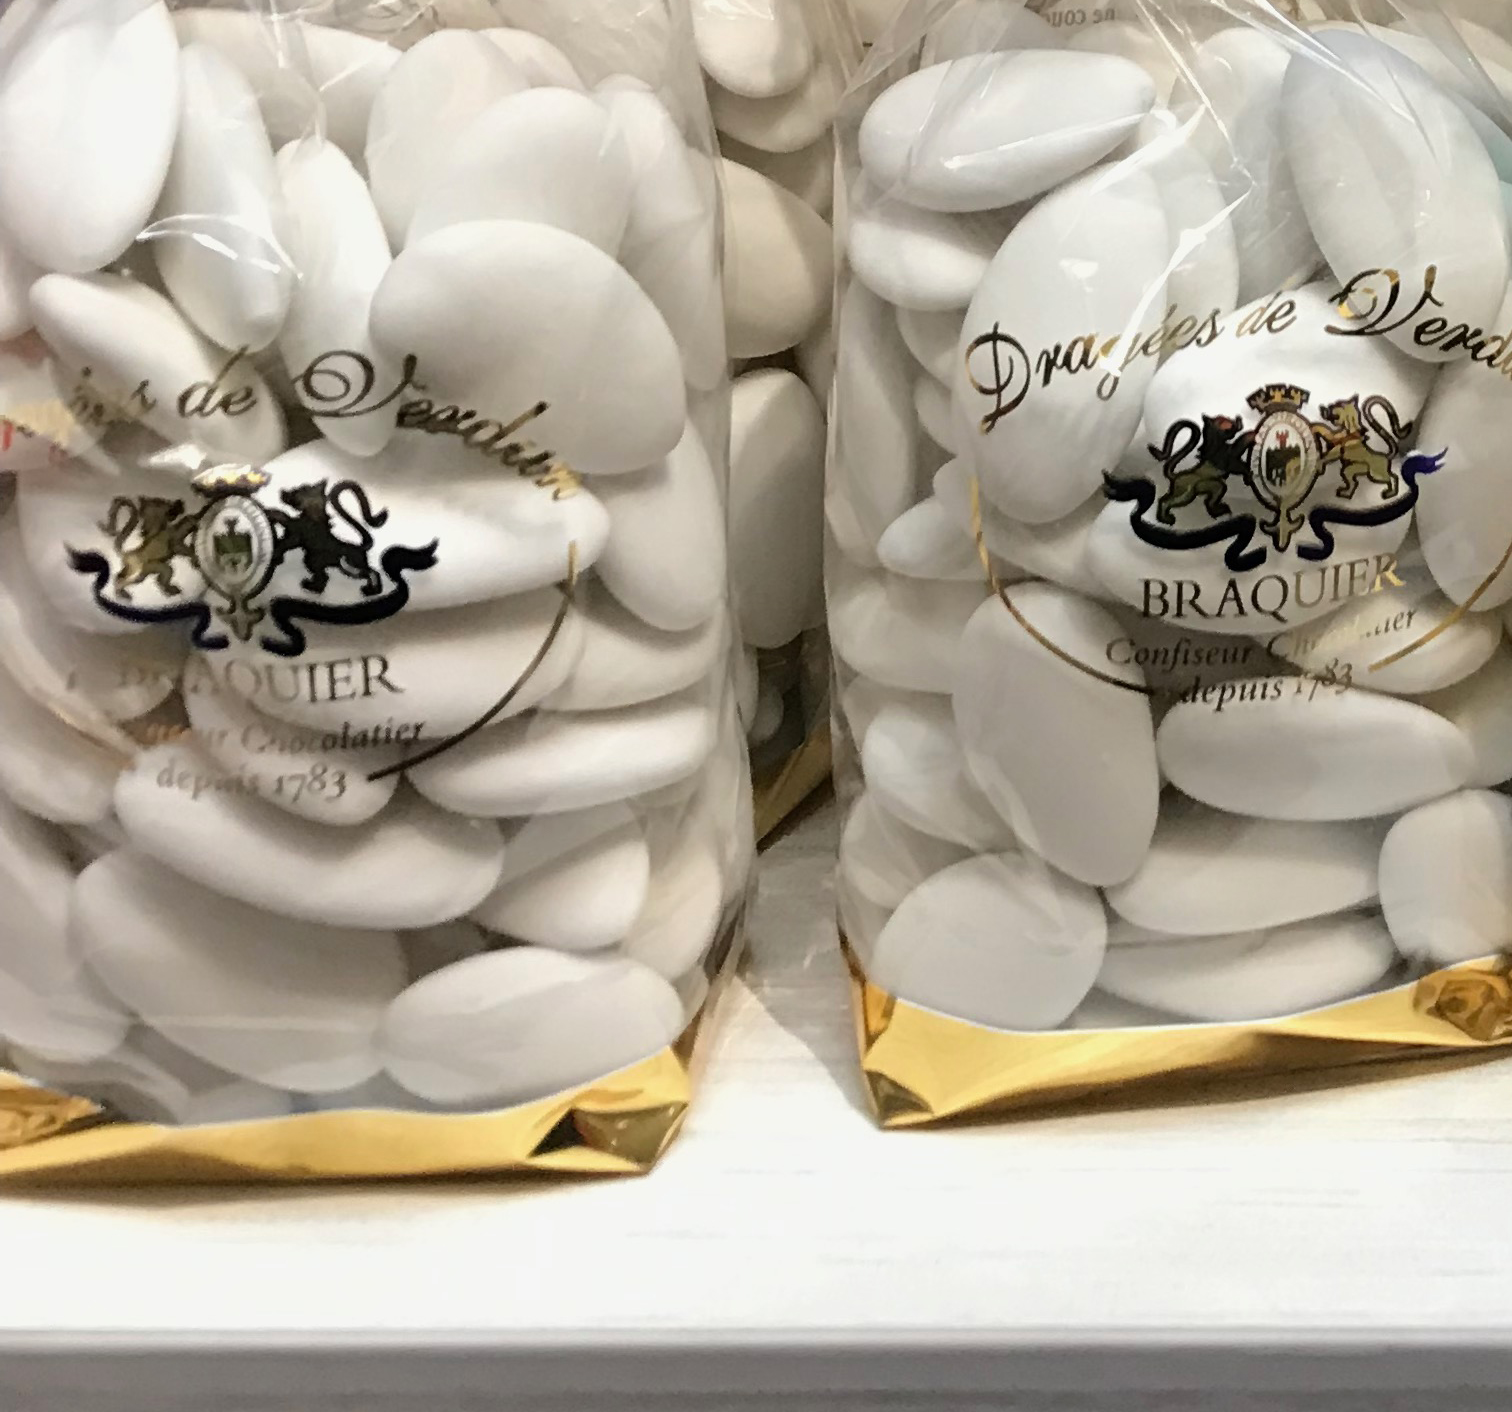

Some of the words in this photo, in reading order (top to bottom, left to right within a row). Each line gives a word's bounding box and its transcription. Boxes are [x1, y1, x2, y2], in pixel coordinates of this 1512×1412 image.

[176, 344, 259, 419] de
[964, 302, 1226, 436] Dragées
[1235, 274, 1300, 339] de
[1138, 552, 1407, 624] BRAQUIER
[1105, 635, 1254, 674] Confiseur
[1180, 674, 1284, 713] depuis
[272, 760, 349, 804] 1783
